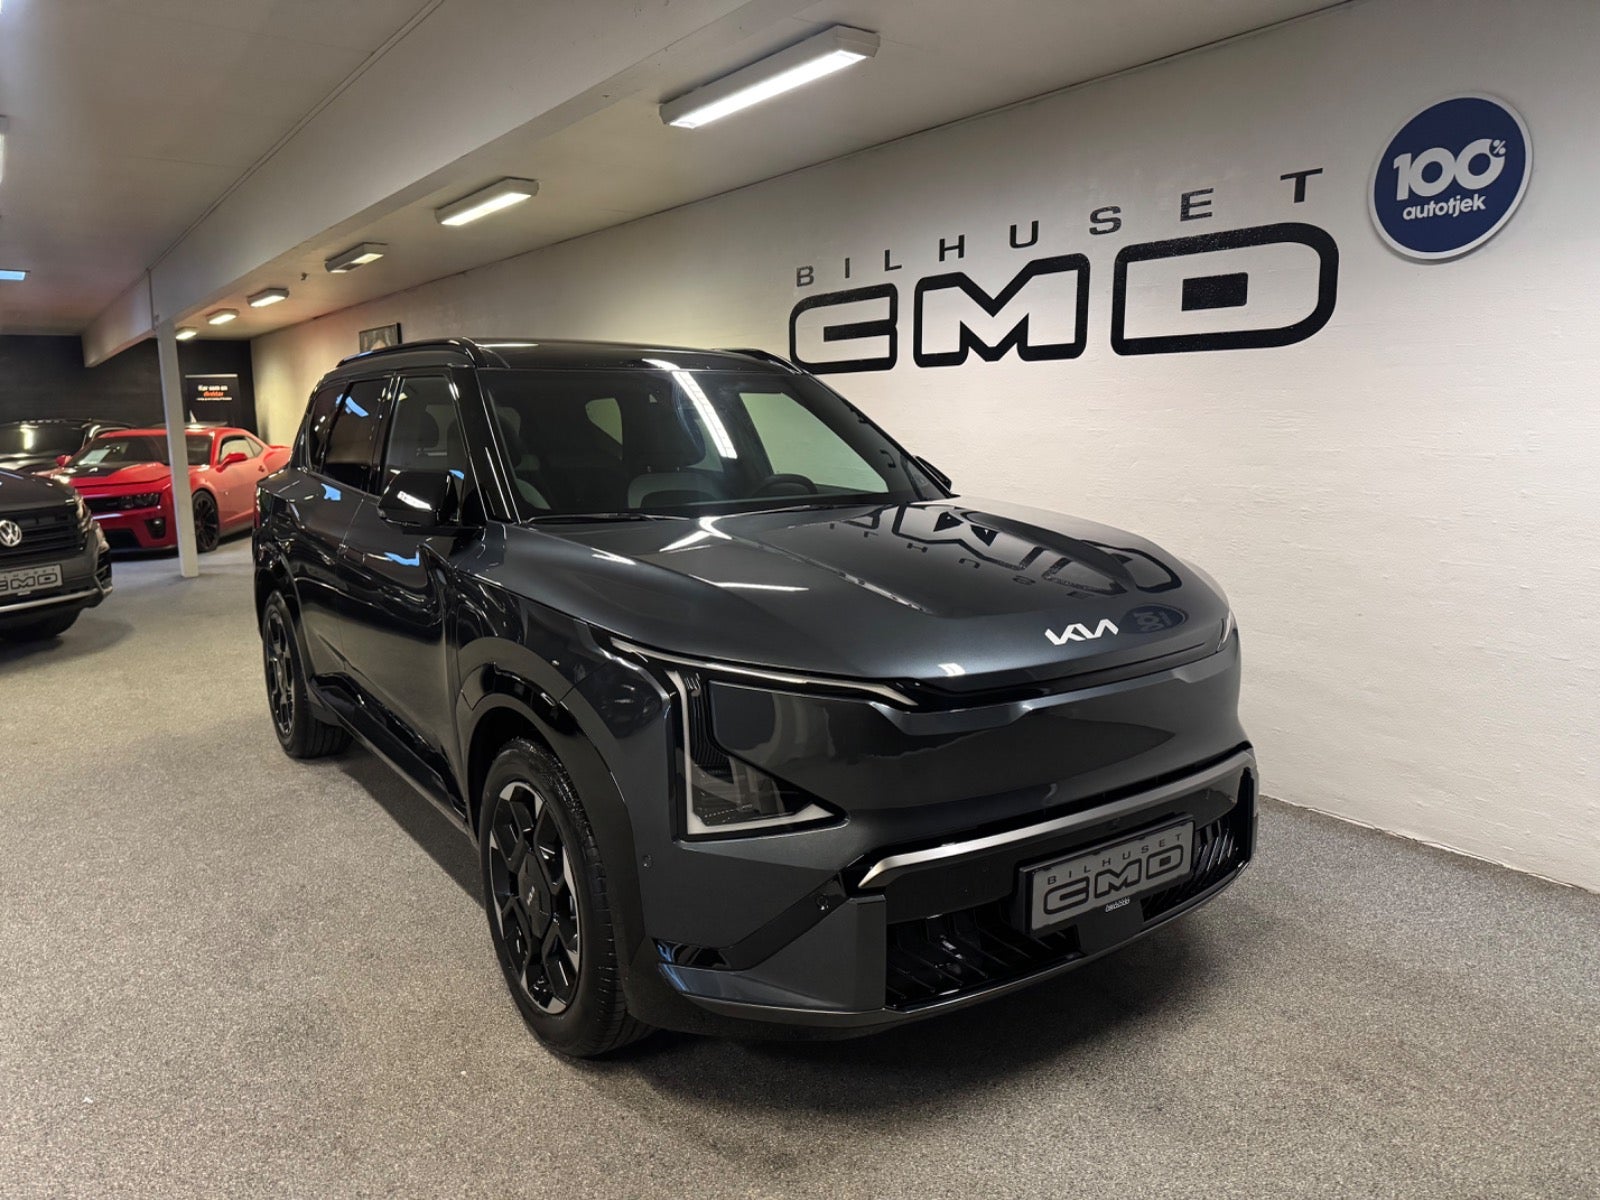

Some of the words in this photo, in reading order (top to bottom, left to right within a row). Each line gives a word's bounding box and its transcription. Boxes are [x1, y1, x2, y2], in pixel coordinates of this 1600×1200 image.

[795, 168, 1323, 288] BILHUSET
[1402, 194, 1487, 220] autotjek
[789, 222, 1340, 374] CMD
[1043, 844, 1184, 915] CMD
[1047, 833, 1183, 885] BILHUSET
